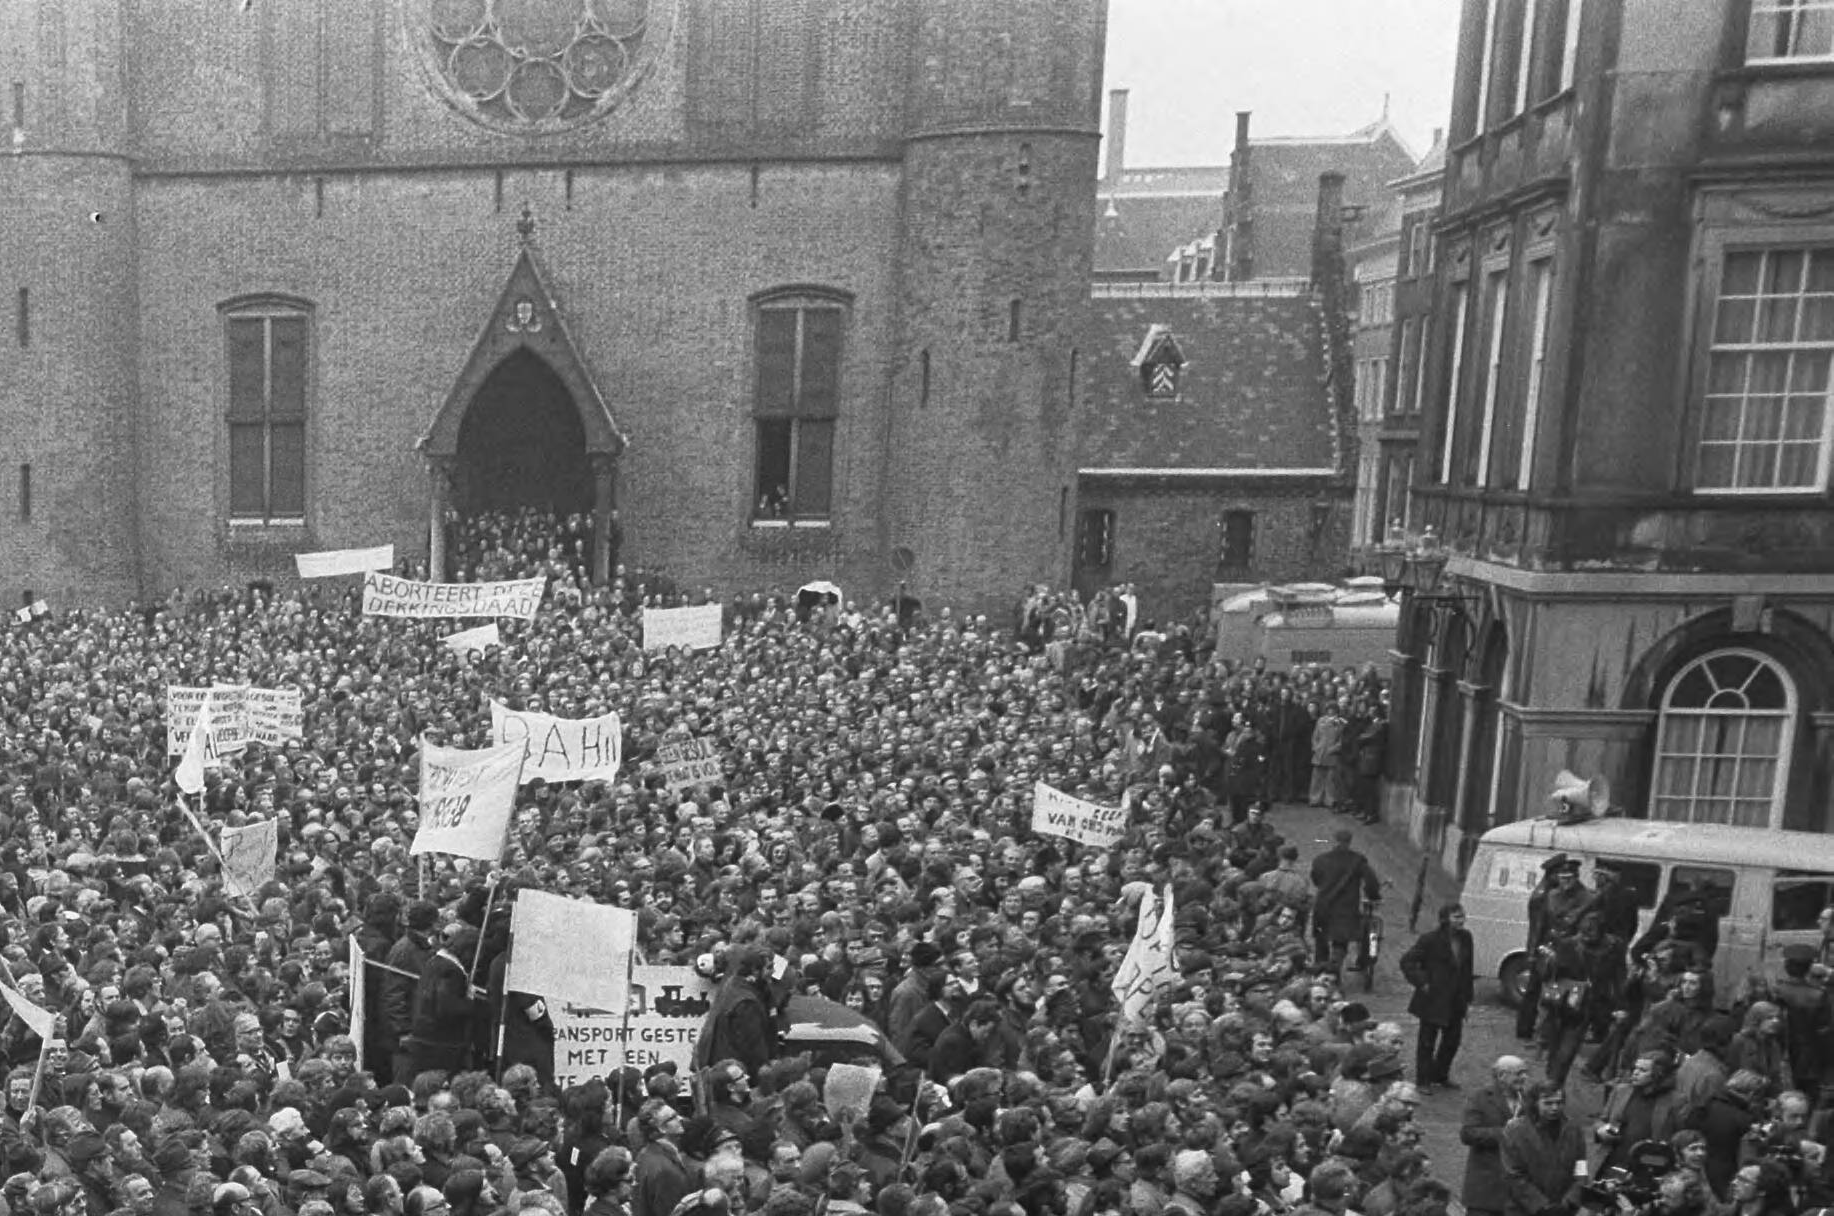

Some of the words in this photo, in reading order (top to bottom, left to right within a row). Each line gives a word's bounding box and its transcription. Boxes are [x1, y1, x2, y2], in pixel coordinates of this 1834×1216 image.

[364, 574, 482, 602] ABORTEERT
[368, 595, 533, 617] DEKKINGSDAAD
[568, 1049, 608, 1066] MET
[624, 1049, 660, 1066] EEN
